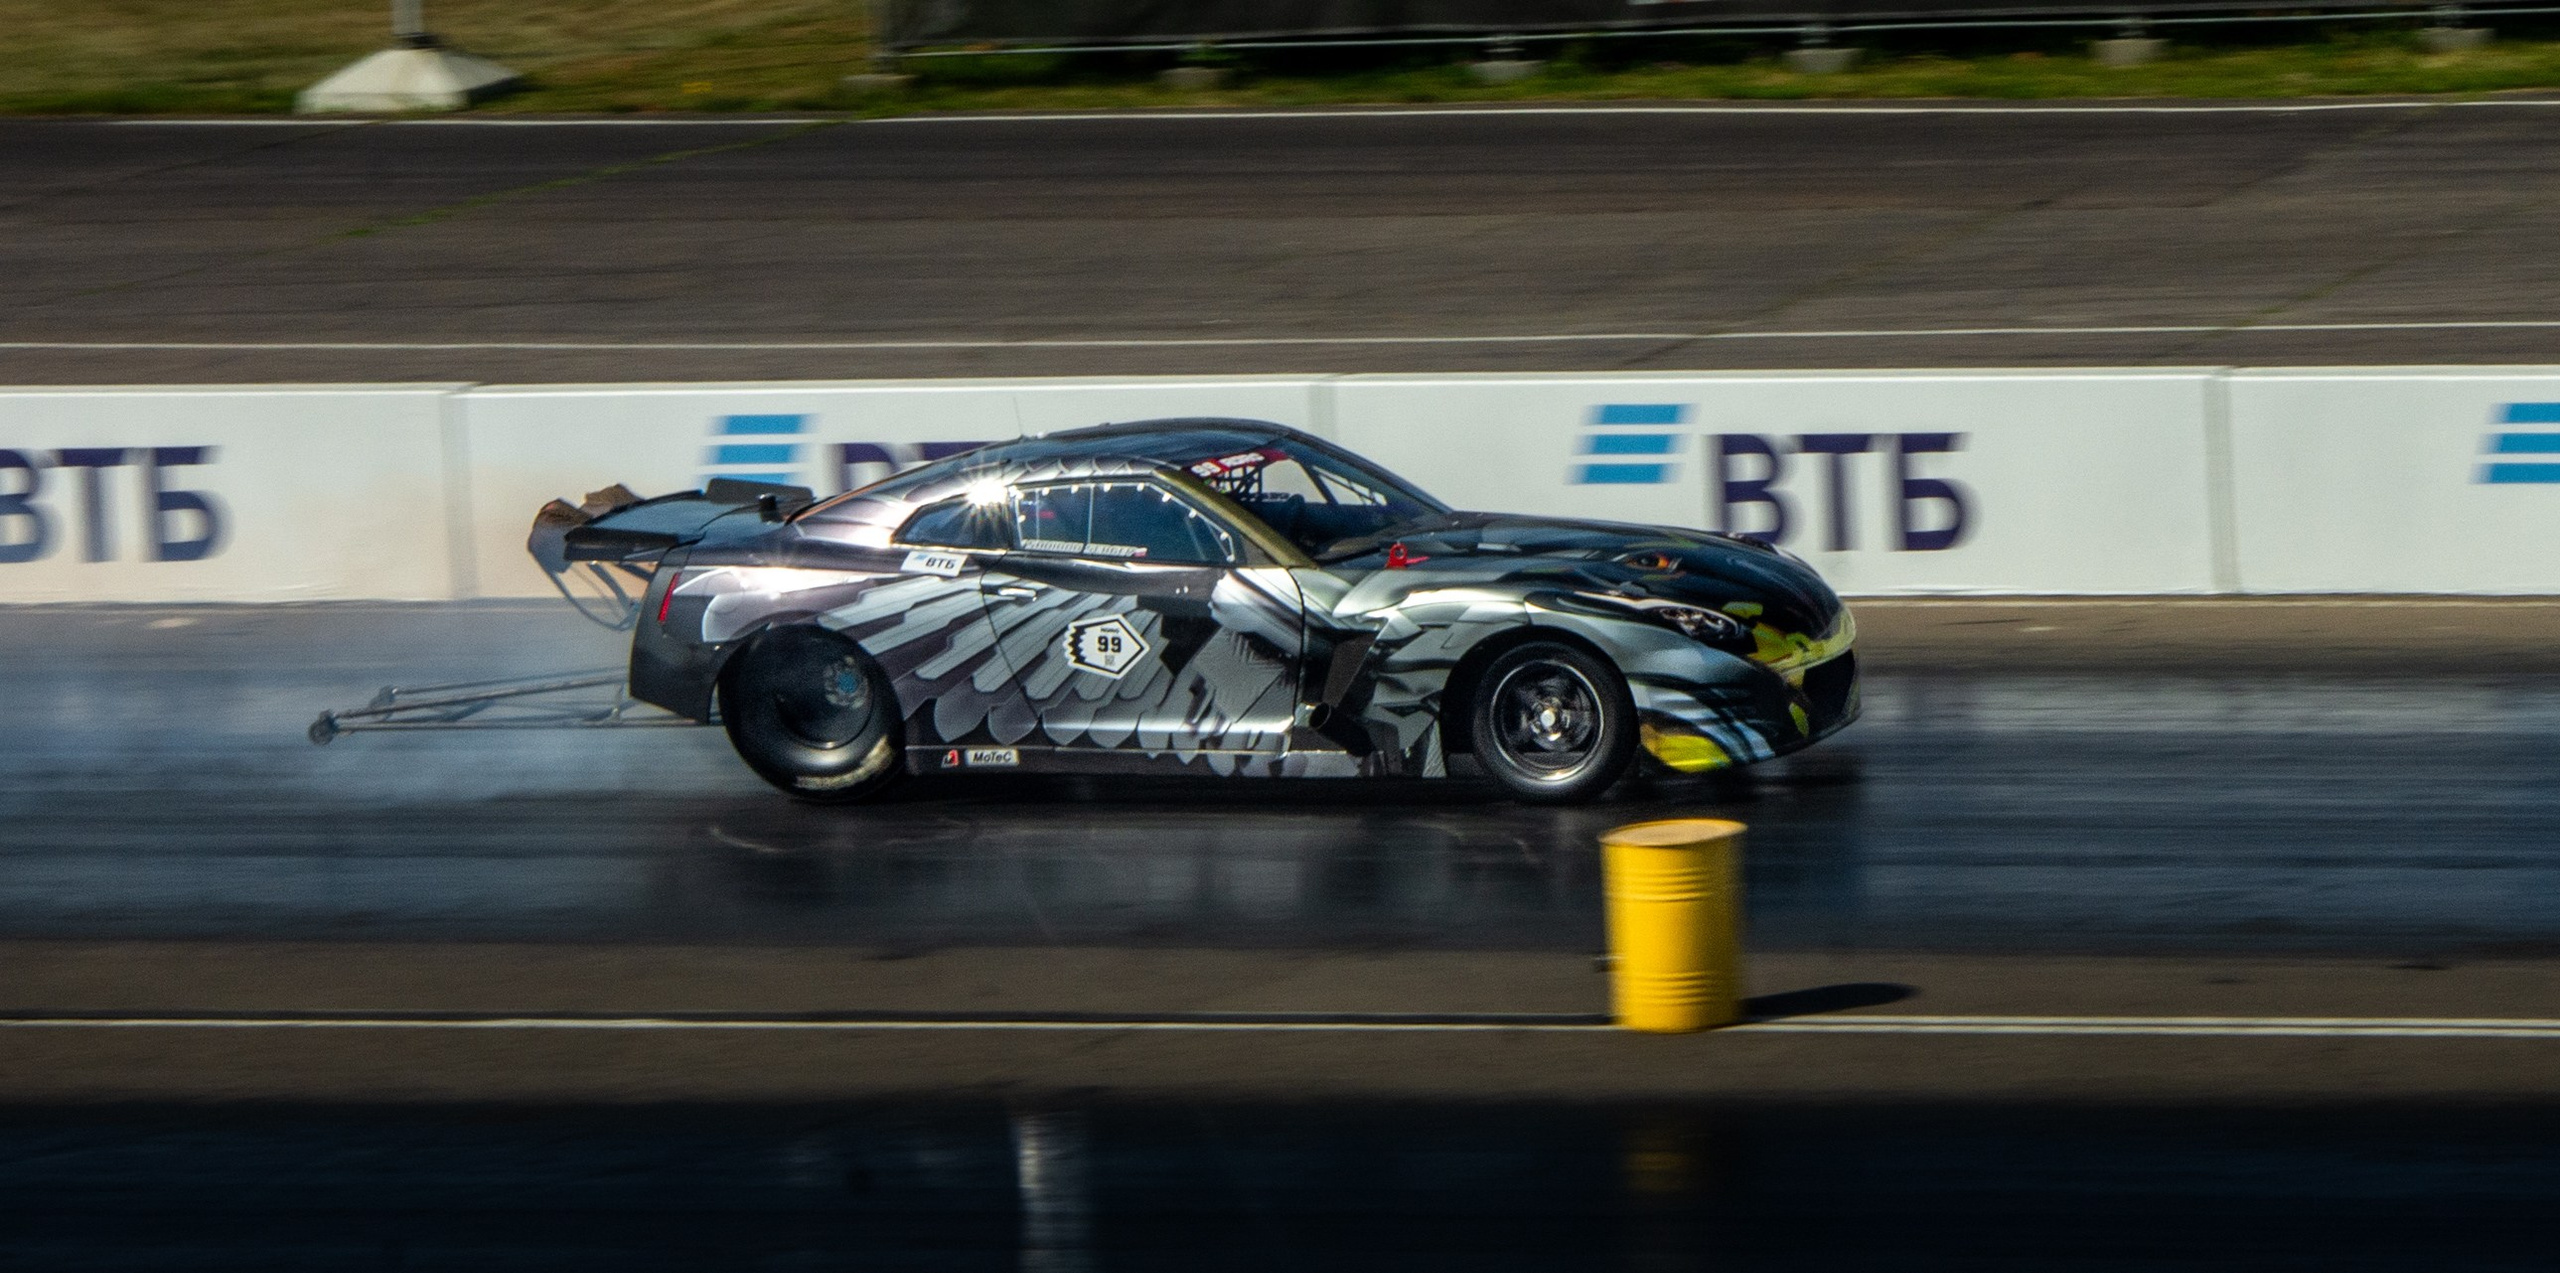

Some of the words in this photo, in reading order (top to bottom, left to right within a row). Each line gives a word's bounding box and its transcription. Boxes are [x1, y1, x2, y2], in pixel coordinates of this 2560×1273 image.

[1706, 433, 1977, 551] ВТБ
[925, 557, 956, 569] ВТБ
[1097, 636, 1121, 653] 99
[973, 752, 1011, 762] MoTeC
